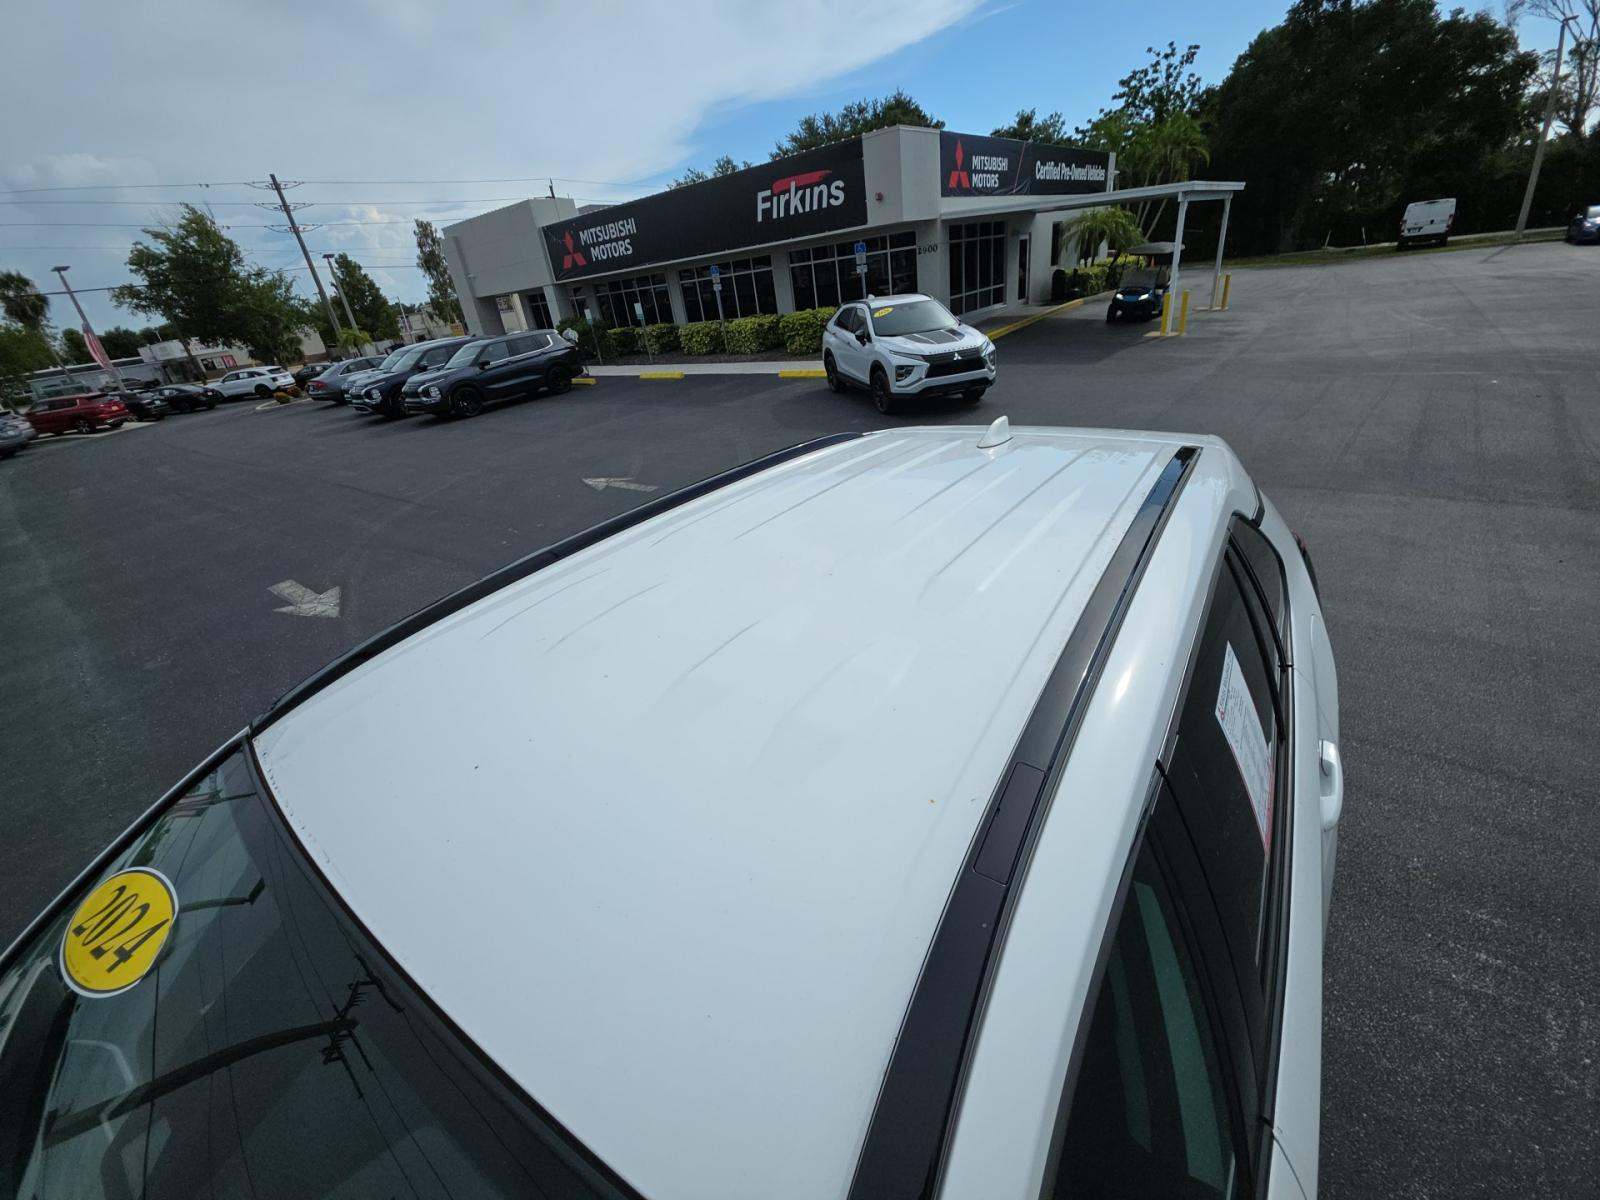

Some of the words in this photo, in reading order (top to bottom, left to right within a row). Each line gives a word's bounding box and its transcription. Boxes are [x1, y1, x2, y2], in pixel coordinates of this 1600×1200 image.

[972, 155, 1008, 172] MITSUBISHI
[1035, 160, 1061, 180] Certified
[1061, 163, 1087, 180] Pre-Owned
[972, 173, 999, 188] MOTORS
[757, 177, 845, 222] Firkins
[579, 217, 637, 245] MITSUBISHI
[590, 239, 633, 263] MOTORS
[72, 885, 169, 974] 2024
